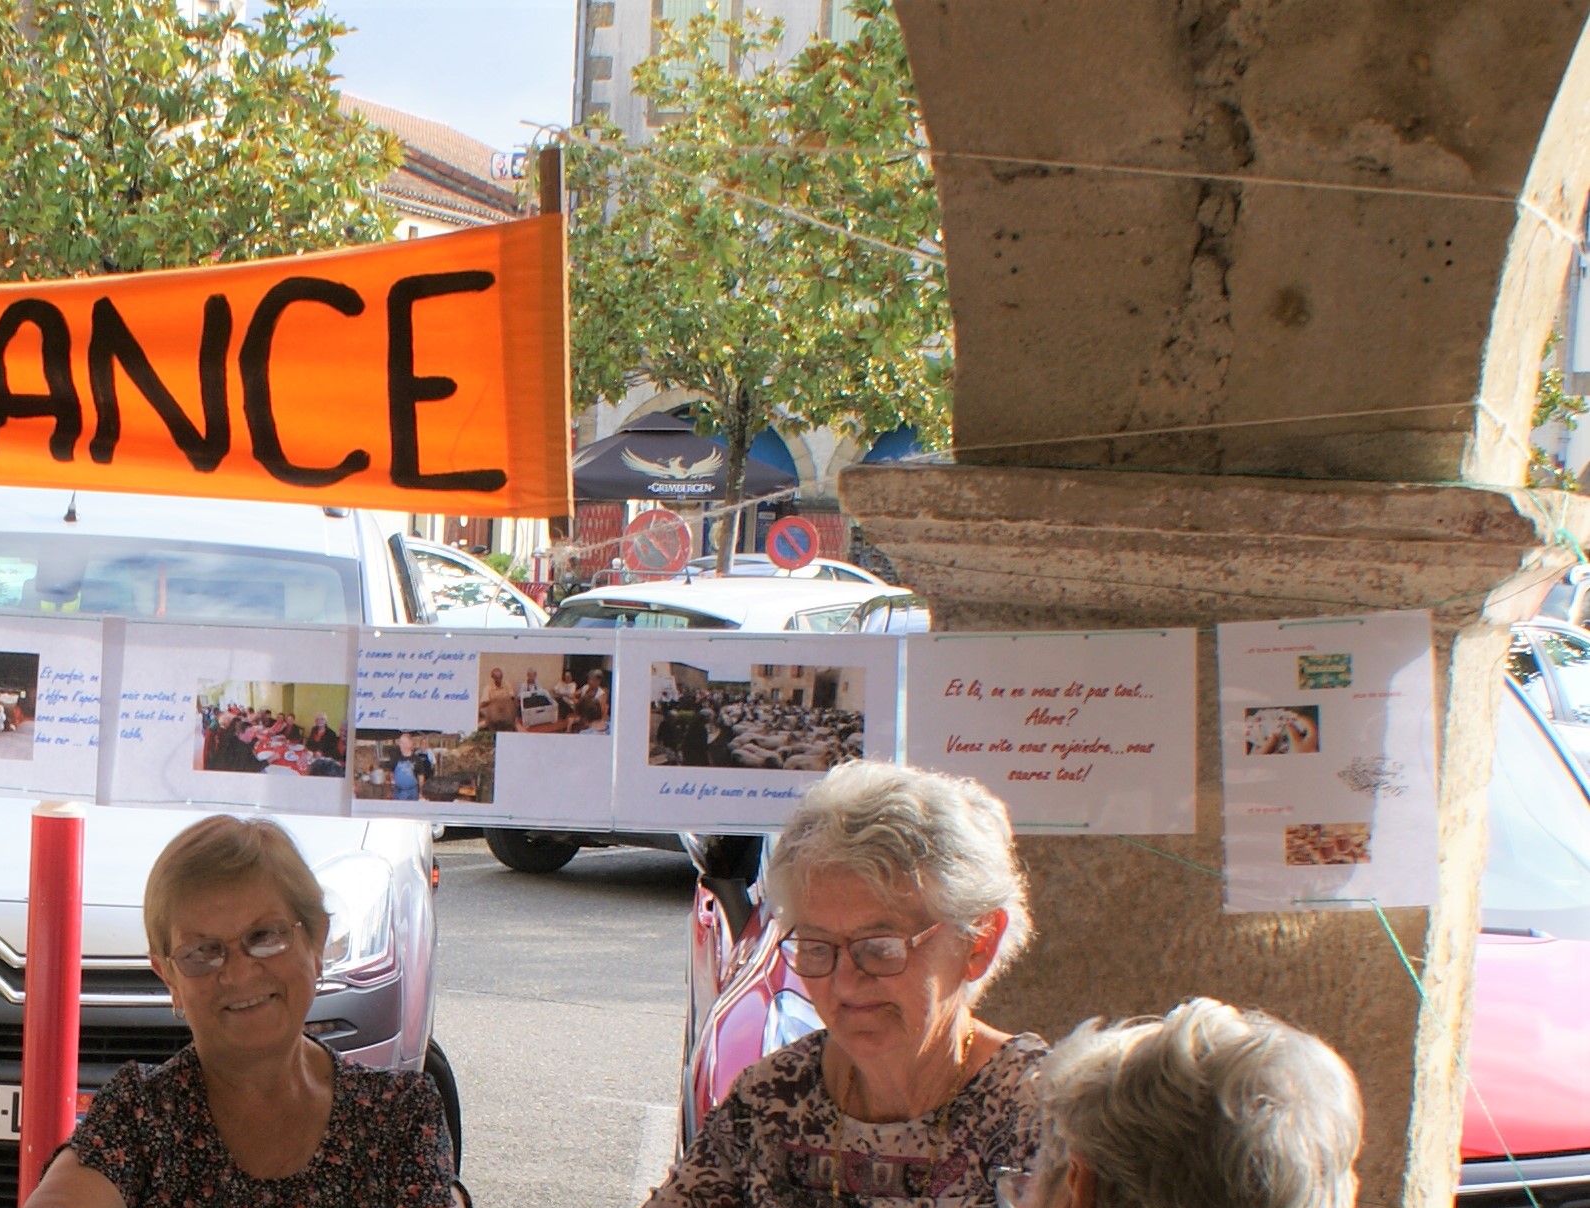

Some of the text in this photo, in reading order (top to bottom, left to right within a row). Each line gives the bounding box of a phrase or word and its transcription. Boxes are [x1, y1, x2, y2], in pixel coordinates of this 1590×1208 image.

[651, 482, 713, 493] GRIMBERGEN
[356, 687, 376, 701] ême,
[944, 678, 1154, 704] Et là, on ne vous dit pas tout...
[1023, 706, 1079, 727] Alors?
[945, 734, 985, 754] Venez
[988, 738, 1013, 753] vite
[1018, 741, 1047, 753] nous
[1006, 763, 1094, 783] saurez tout!
[659, 782, 671, 795] Le
